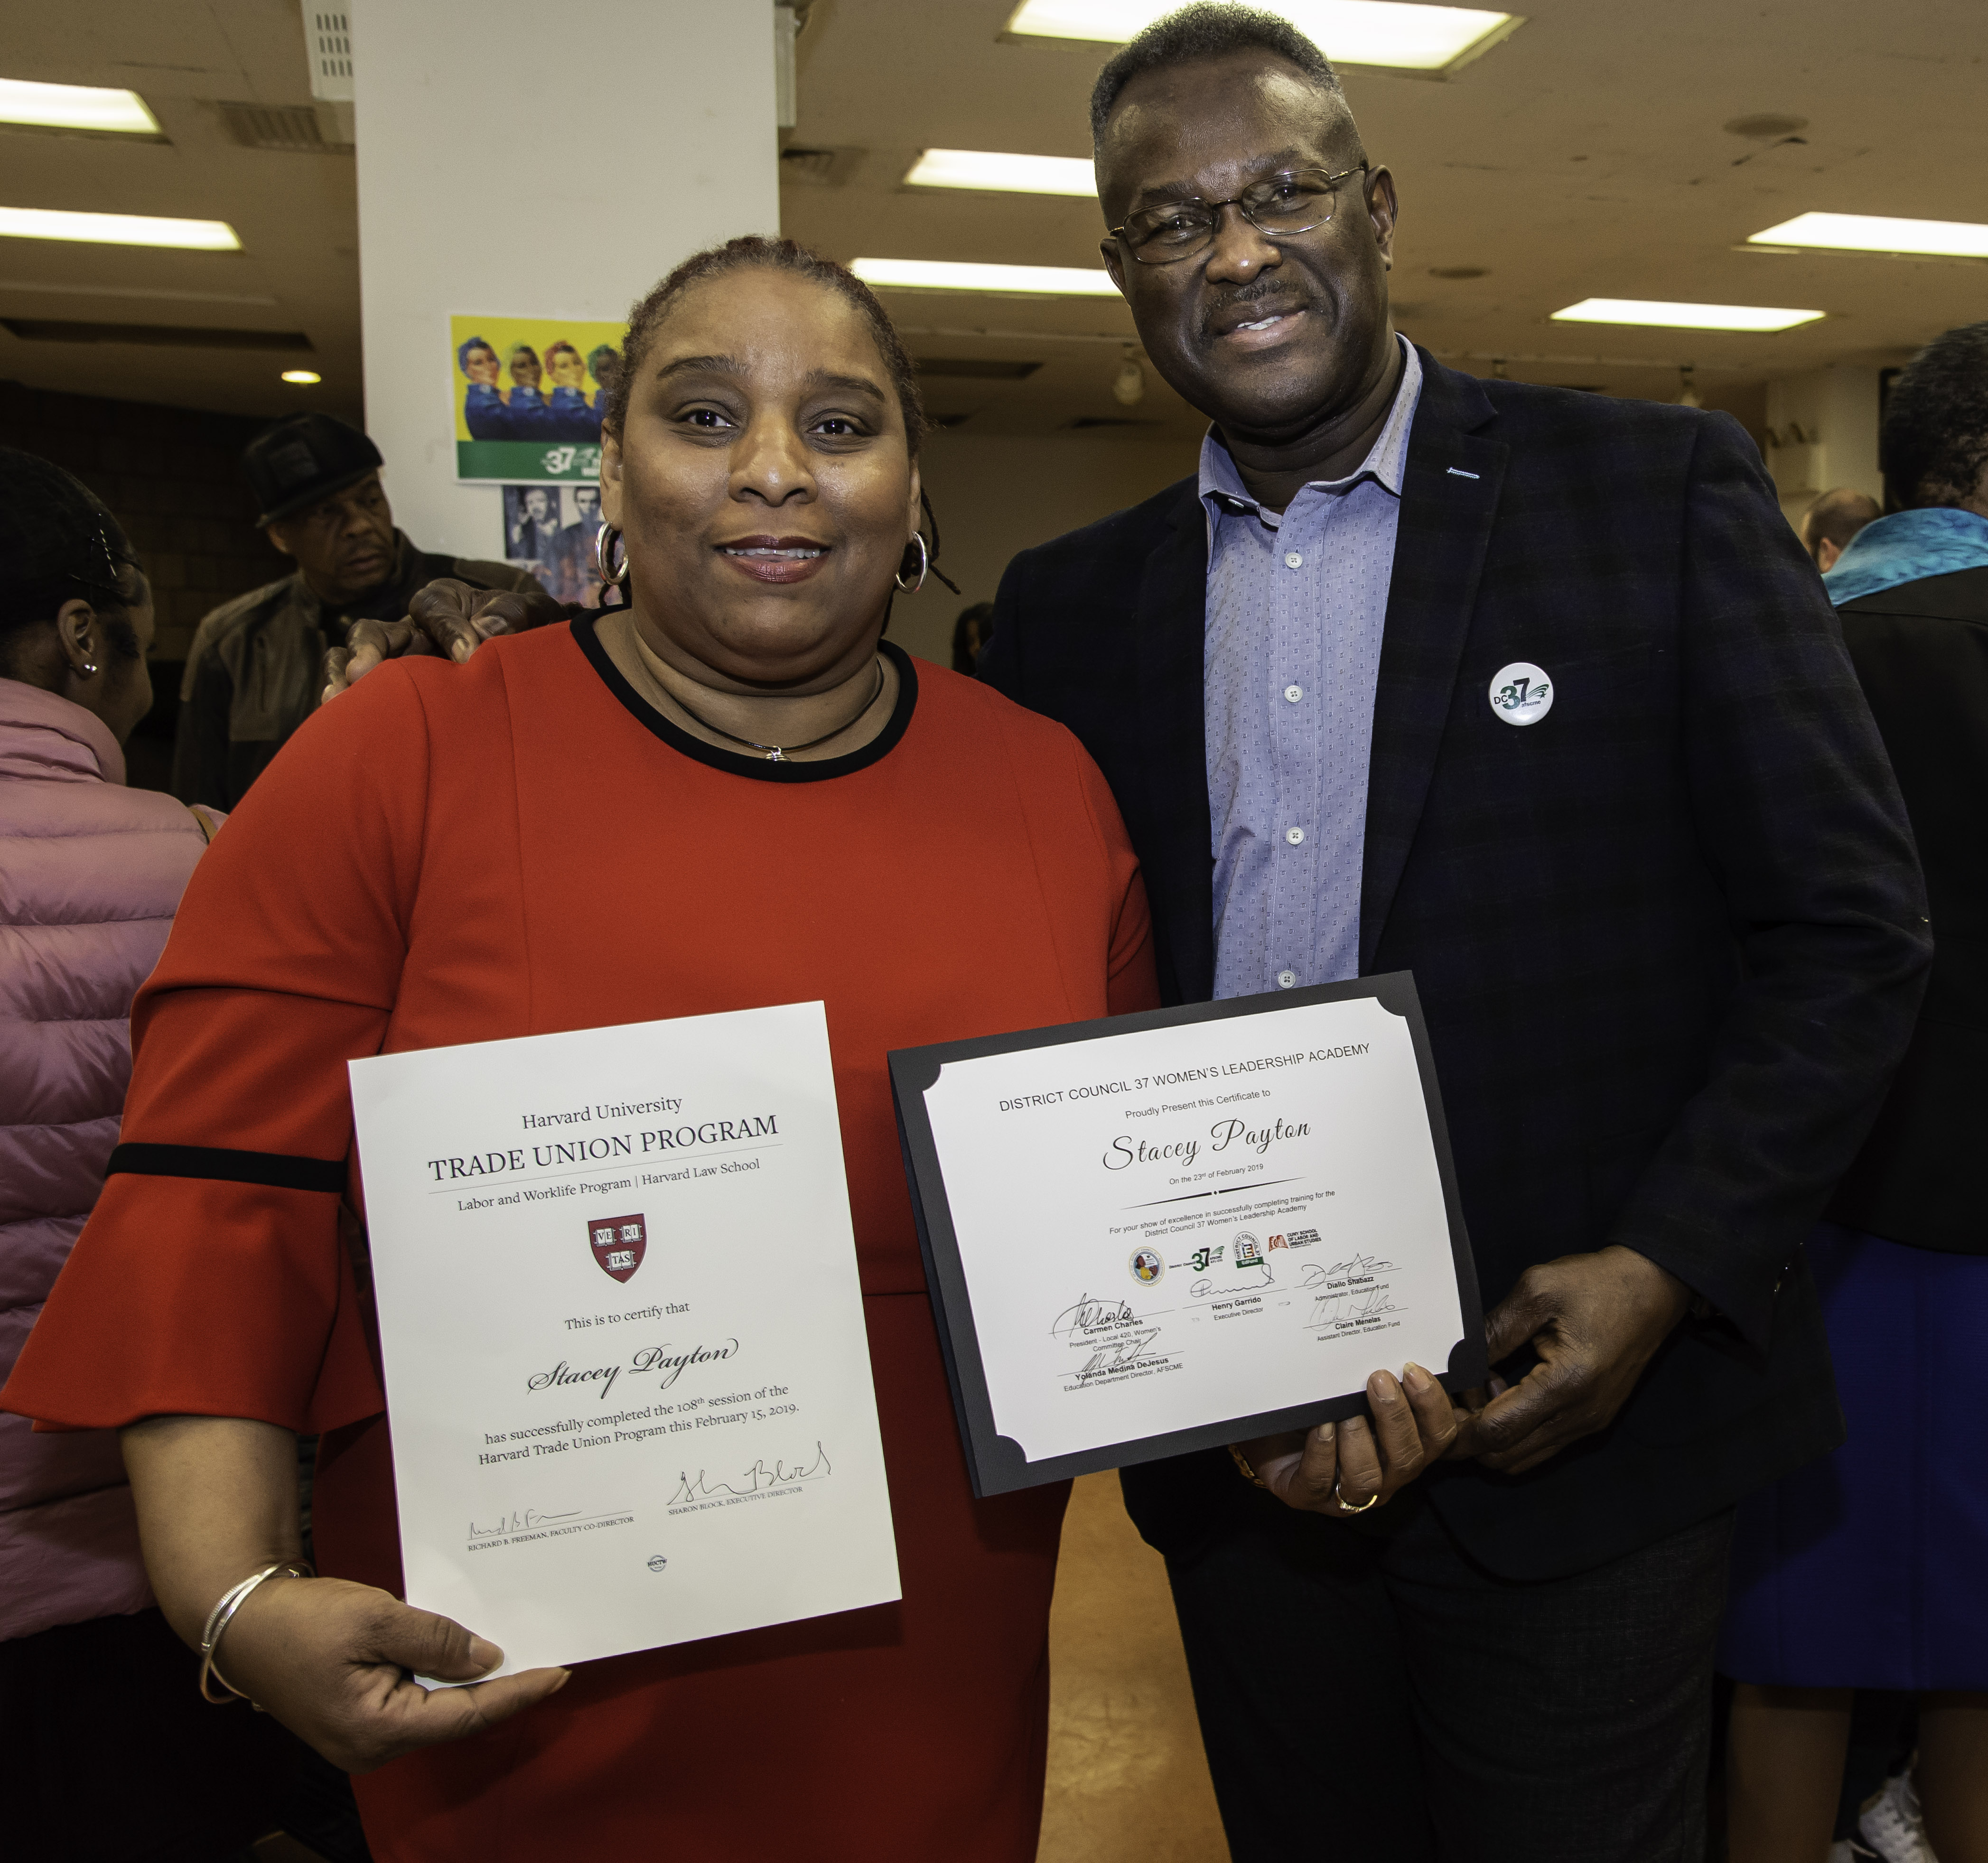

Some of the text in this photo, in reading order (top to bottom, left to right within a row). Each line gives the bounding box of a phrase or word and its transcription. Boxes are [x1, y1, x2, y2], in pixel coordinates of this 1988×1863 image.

[546, 447, 577, 474] 37
[999, 1091, 1064, 1111] DISTRICT
[1069, 1081, 1131, 1099] COUNCIL
[1135, 1078, 1148, 1089] 37
[1222, 1053, 1304, 1075] LEADERSHIP
[1309, 1043, 1369, 1062] ACADEMY
[523, 1097, 682, 1129] Harvard University
[1125, 1107, 1159, 1118] Proudly
[1162, 1101, 1196, 1112] Present
[1198, 1099, 1214, 1107] this
[1217, 1091, 1260, 1104] Certificate
[429, 1115, 778, 1181] TRADE UNION PROGRAM
[1103, 1118, 1311, 1170] Stacey Payton
[458, 1198, 495, 1211] Labor
[498, 1192, 521, 1205] and
[523, 1185, 576, 1201] Worklife
[580, 1180, 631, 1194] Program
[642, 1168, 691, 1184] Harvard
[693, 1168, 717, 1177] Law
[721, 1159, 759, 1174] School
[1194, 1173, 1206, 1181] 23rd
[1217, 1168, 1245, 1177] February
[1248, 1164, 1263, 1172] 2019
[1123, 1225, 1139, 1233] your
[1168, 1213, 1203, 1224] excellence
[1213, 1204, 1252, 1216] successfully
[1254, 1199, 1288, 1209] completing
[1291, 1194, 1314, 1202] training
[1145, 1228, 1168, 1237] District
[1170, 1223, 1195, 1232] Council
[1207, 1216, 1238, 1226] Women's
[1240, 1209, 1275, 1220] Leadership
[1278, 1205, 1307, 1214] Academy
[598, 1228, 636, 1240] VE RI
[1241, 1234, 1259, 1249] COUNCIL
[612, 1254, 630, 1264] TAS
[1192, 1248, 1210, 1272] 37
[1315, 1292, 1350, 1302] Administrator,
[1351, 1285, 1376, 1295] Education
[1327, 1276, 1374, 1289] Diallo Shabazz
[565, 1303, 690, 1330] This is to certify that
[1212, 1297, 1261, 1311] Henry Garrido
[1214, 1307, 1264, 1321] Executive Director
[1083, 1319, 1143, 1335] Carmen Charles
[1317, 1333, 1340, 1342] Assistant
[1342, 1329, 1363, 1337] Director,
[1363, 1324, 1388, 1332] Education
[1355, 1316, 1381, 1326] Menelas
[1070, 1339, 1097, 1348] President
[1135, 1326, 1162, 1336] Women's
[1093, 1342, 1125, 1352] Committee
[527, 1338, 739, 1399] Stacey Payton
[1064, 1363, 1184, 1391] Education Department Director, AFSCME
[1075, 1369, 1106, 1381] Yolanda
[1108, 1365, 1135, 1374] Medina
[1137, 1358, 1169, 1369] DeJesus
[485, 1386, 788, 1444] has successfully completed the 108th session of the
[479, 1404, 799, 1465] Harvard Trade Union Program this February 15, 2019.
[669, 1487, 803, 1515] SHARON BLOCK, EXECUTIVE DIRECTOR
[468, 1540, 502, 1551] RICHARD
[512, 1532, 549, 1543] FREEMAN,
[551, 1526, 582, 1537] FACULTY
[584, 1517, 634, 1530] CO-DIRECTOR
